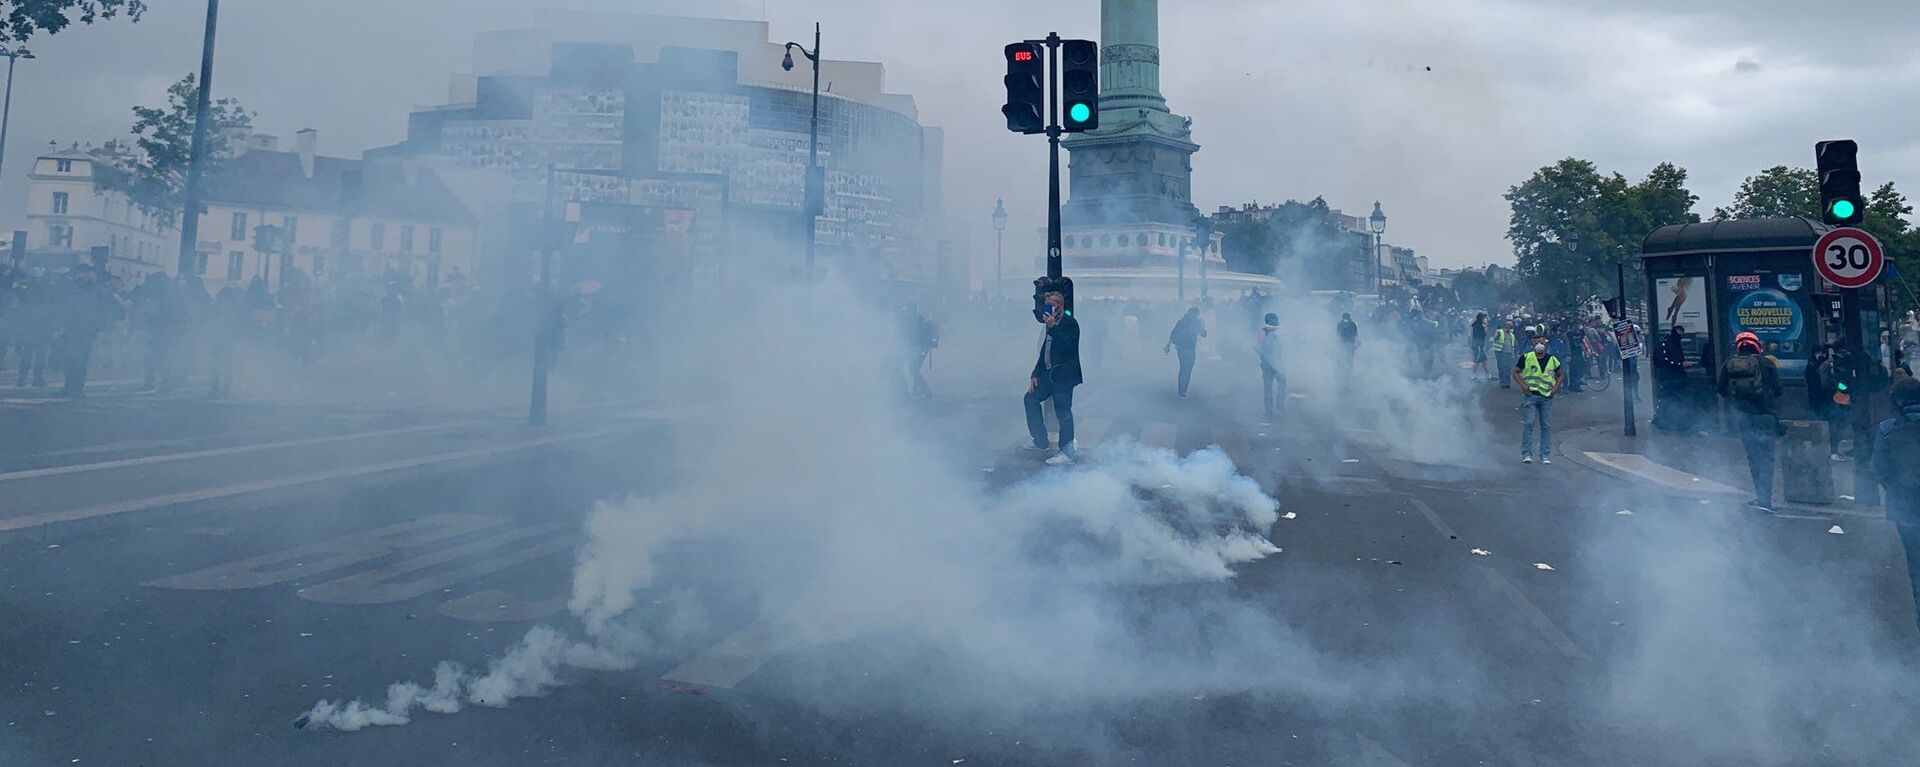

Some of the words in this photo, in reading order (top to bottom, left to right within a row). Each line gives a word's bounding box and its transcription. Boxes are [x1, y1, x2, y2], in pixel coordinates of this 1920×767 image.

[1015, 51, 1032, 61] BUS
[1828, 244, 1869, 270] 30
[1729, 275, 1760, 284] SCIENCES
[1738, 308, 1750, 316] LES
[1751, 308, 1792, 316] NOUVELLES
